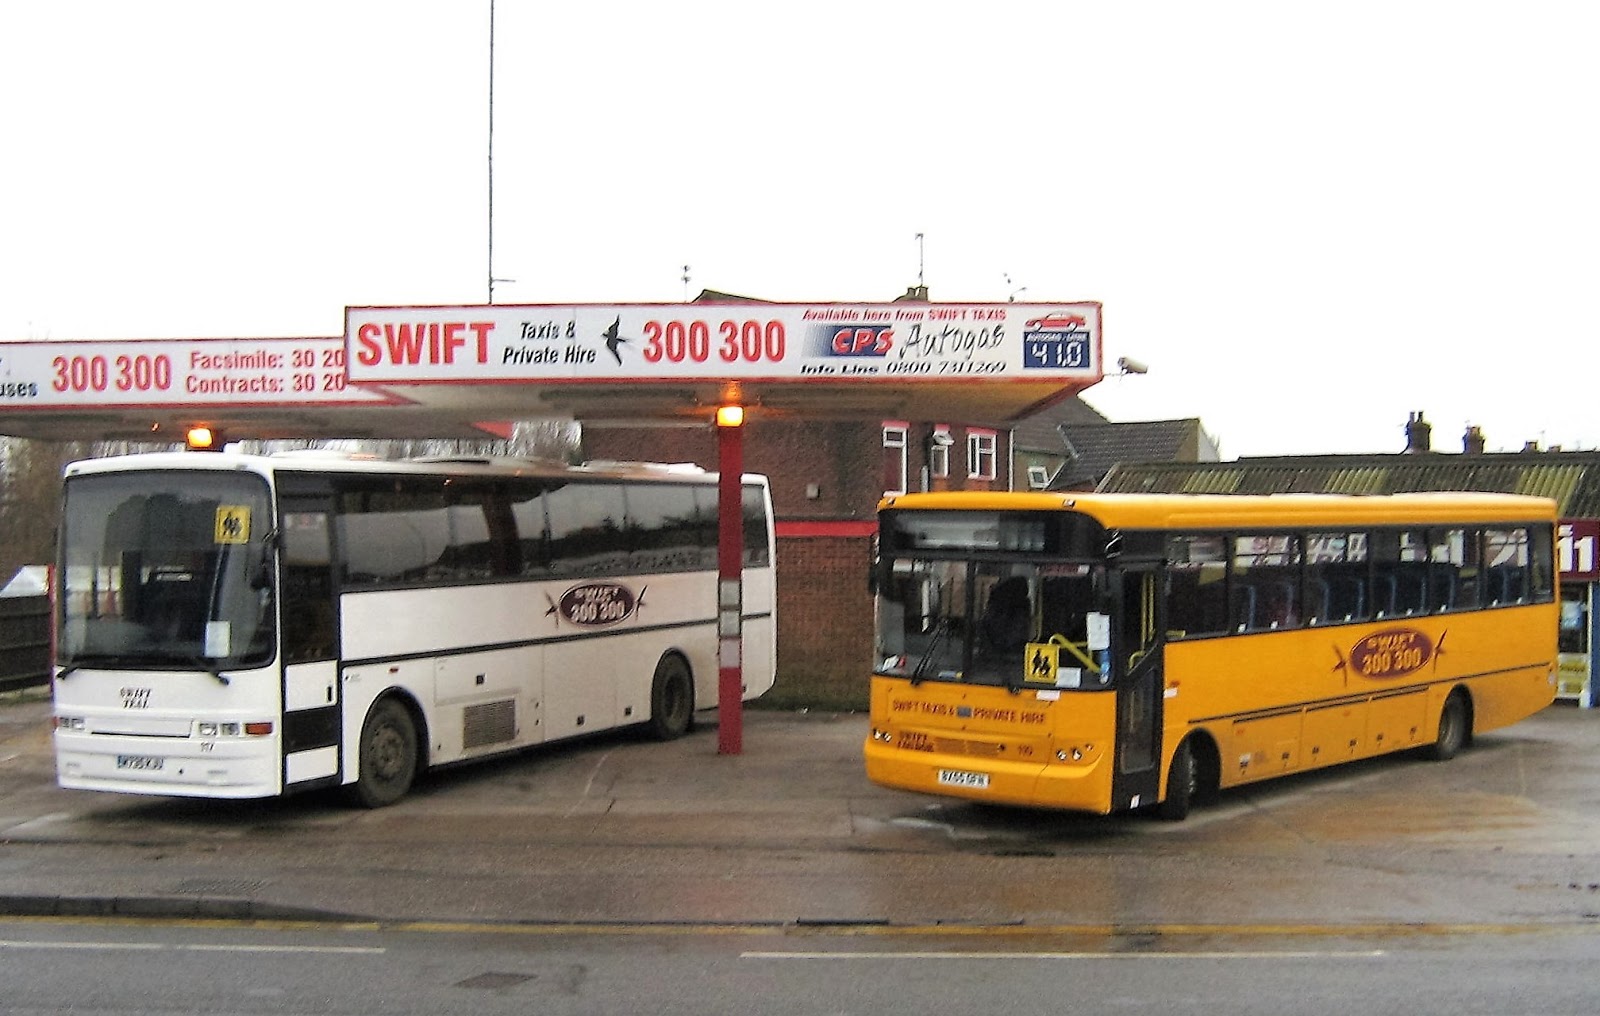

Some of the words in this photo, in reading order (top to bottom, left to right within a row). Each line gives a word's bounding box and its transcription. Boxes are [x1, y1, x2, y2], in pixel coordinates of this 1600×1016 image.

[802, 309, 859, 321] Available
[863, 309, 890, 320] here
[895, 309, 924, 321] from
[928, 309, 966, 320] SWIFT
[971, 308, 1007, 320] TAXIS
[520, 321, 559, 340] Taxis
[564, 321, 576, 339] &
[643, 320, 710, 363] 300
[719, 319, 785, 362] 300
[832, 328, 895, 355] CPS
[900, 323, 1006, 360] Autogas
[357, 322, 496, 366] SWIFT
[502, 346, 559, 365] Private
[564, 345, 596, 364] Hire
[190, 351, 283, 369] Facsimile:
[292, 350, 314, 368] 30
[801, 365, 835, 374] Info
[841, 364, 879, 374] Line
[887, 361, 931, 374] 0800
[53, 355, 107, 392] 300
[116, 354, 171, 391] 300
[187, 375, 283, 393] Contracts:
[292, 375, 314, 392] 30
[571, 603, 597, 622] 300
[600, 600, 625, 620] 300
[1367, 632, 1417, 650] SWIFT
[1362, 650, 1391, 675] 300
[1395, 647, 1421, 671] 300
[893, 700, 918, 711] SWIFT
[922, 702, 947, 716] TAXIS
[973, 707, 1017, 723] PRIVATE
